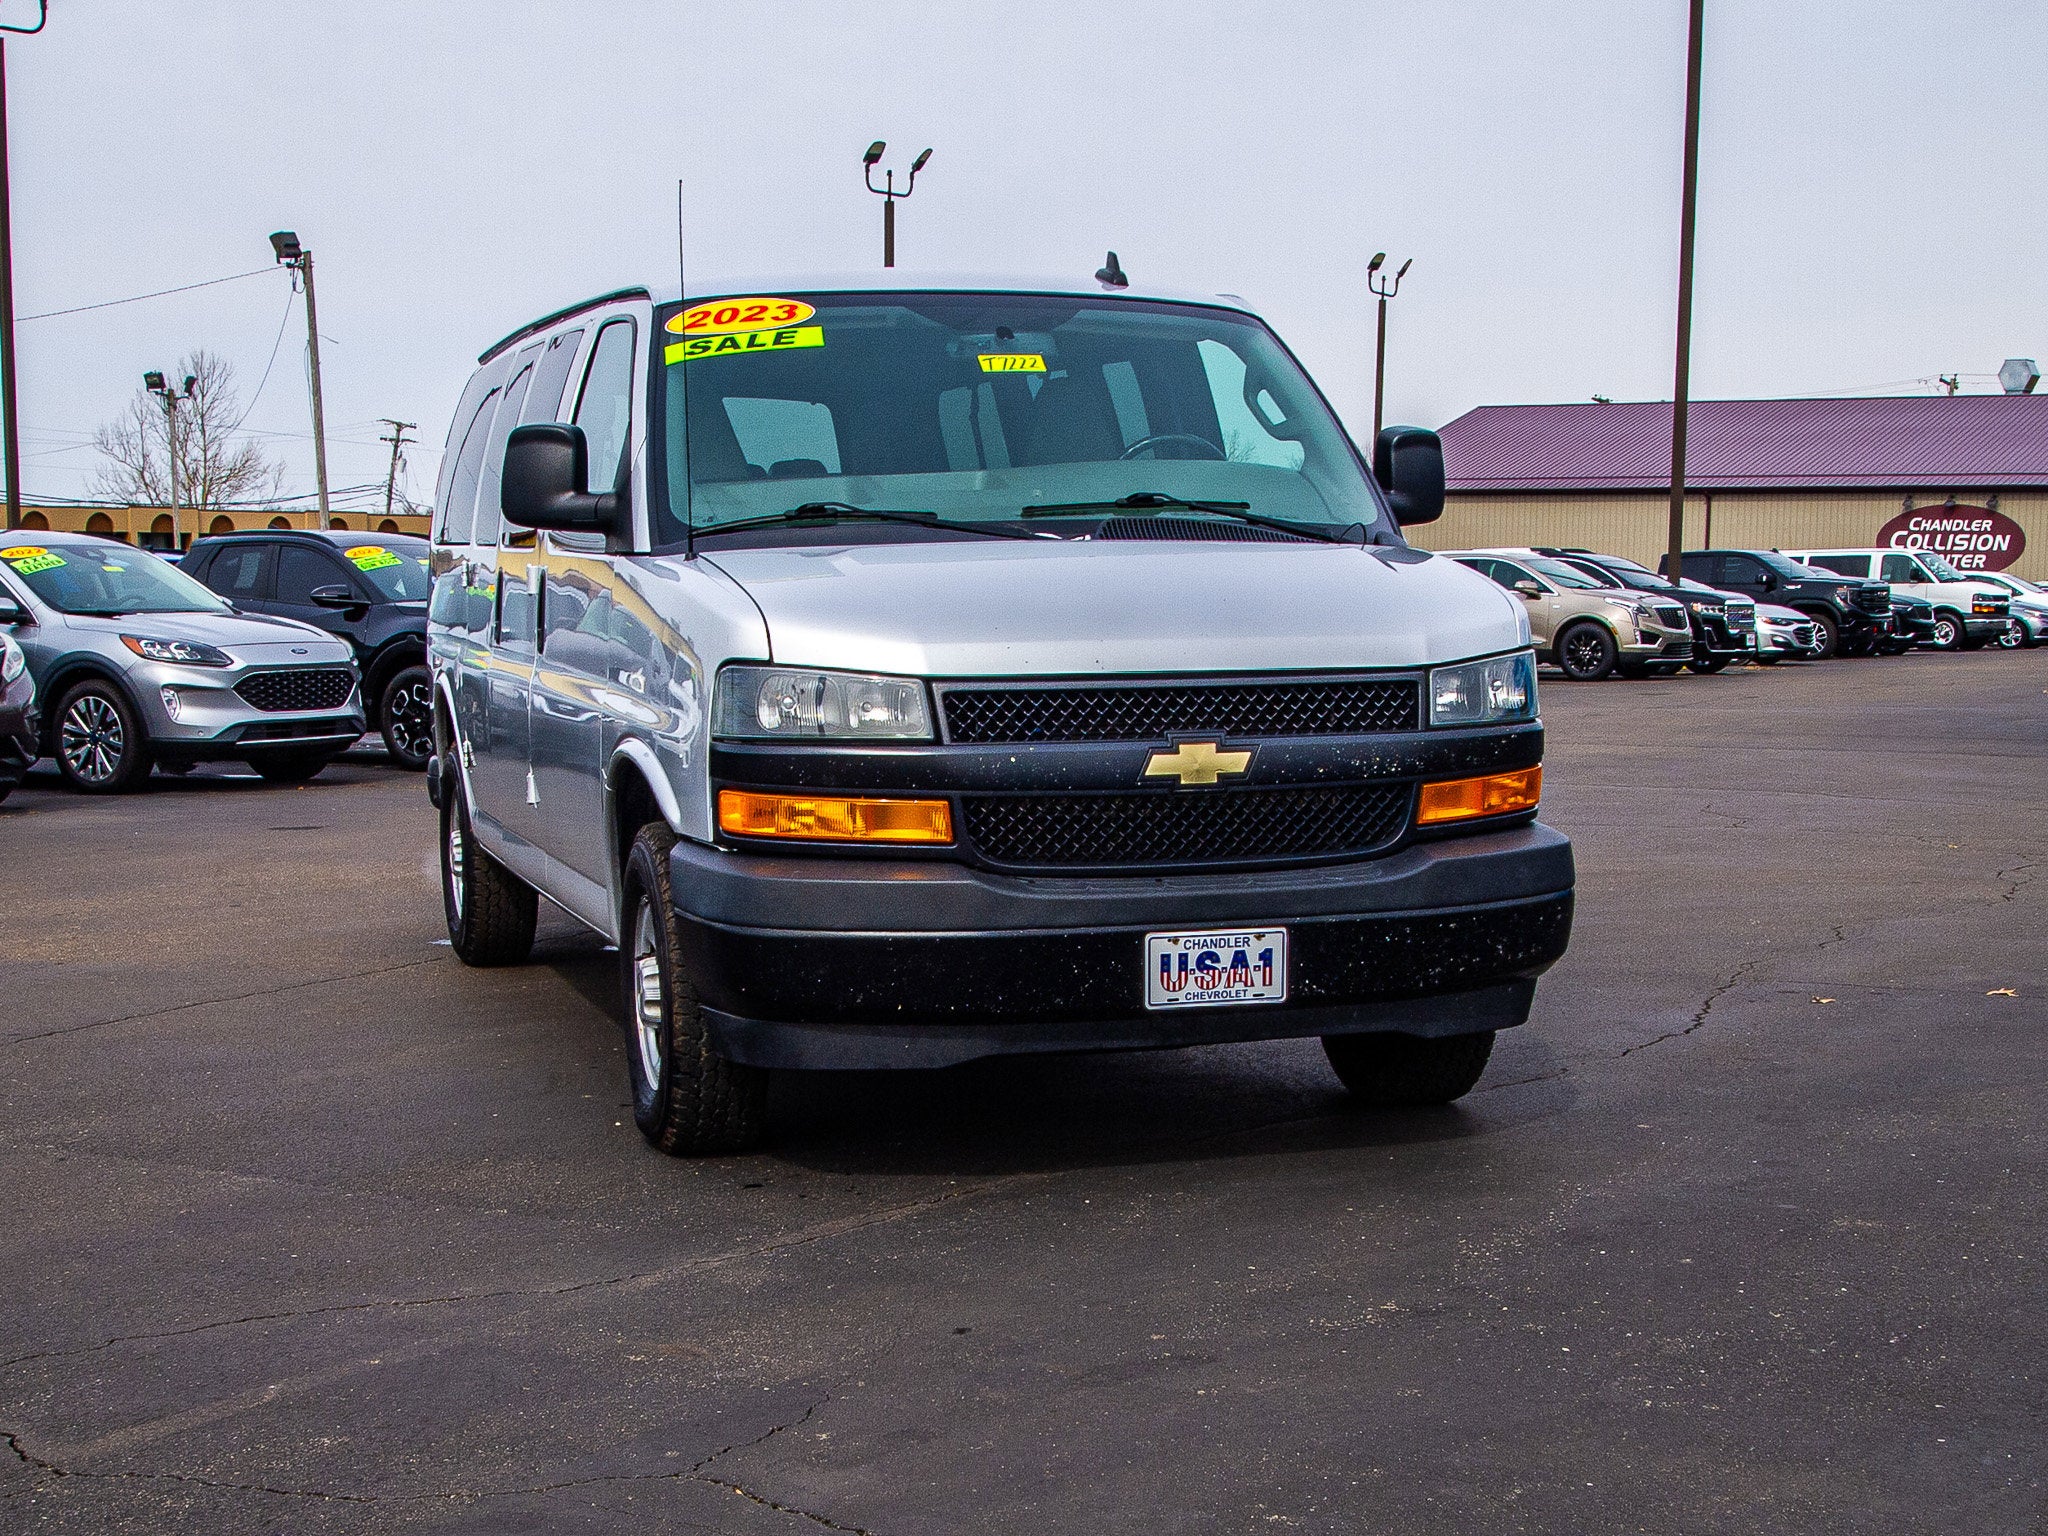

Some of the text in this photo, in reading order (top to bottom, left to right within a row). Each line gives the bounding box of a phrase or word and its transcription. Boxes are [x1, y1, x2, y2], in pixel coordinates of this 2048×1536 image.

[684, 305, 798, 330] 2023
[685, 331, 798, 355] SALE
[1909, 517, 1993, 531] CHANDLER
[1890, 531, 2011, 551] COLLISION
[1937, 554, 1987, 568] TER
[1183, 936, 1250, 950] CHANDLER
[1184, 989, 1249, 1001] CHEVROLET
